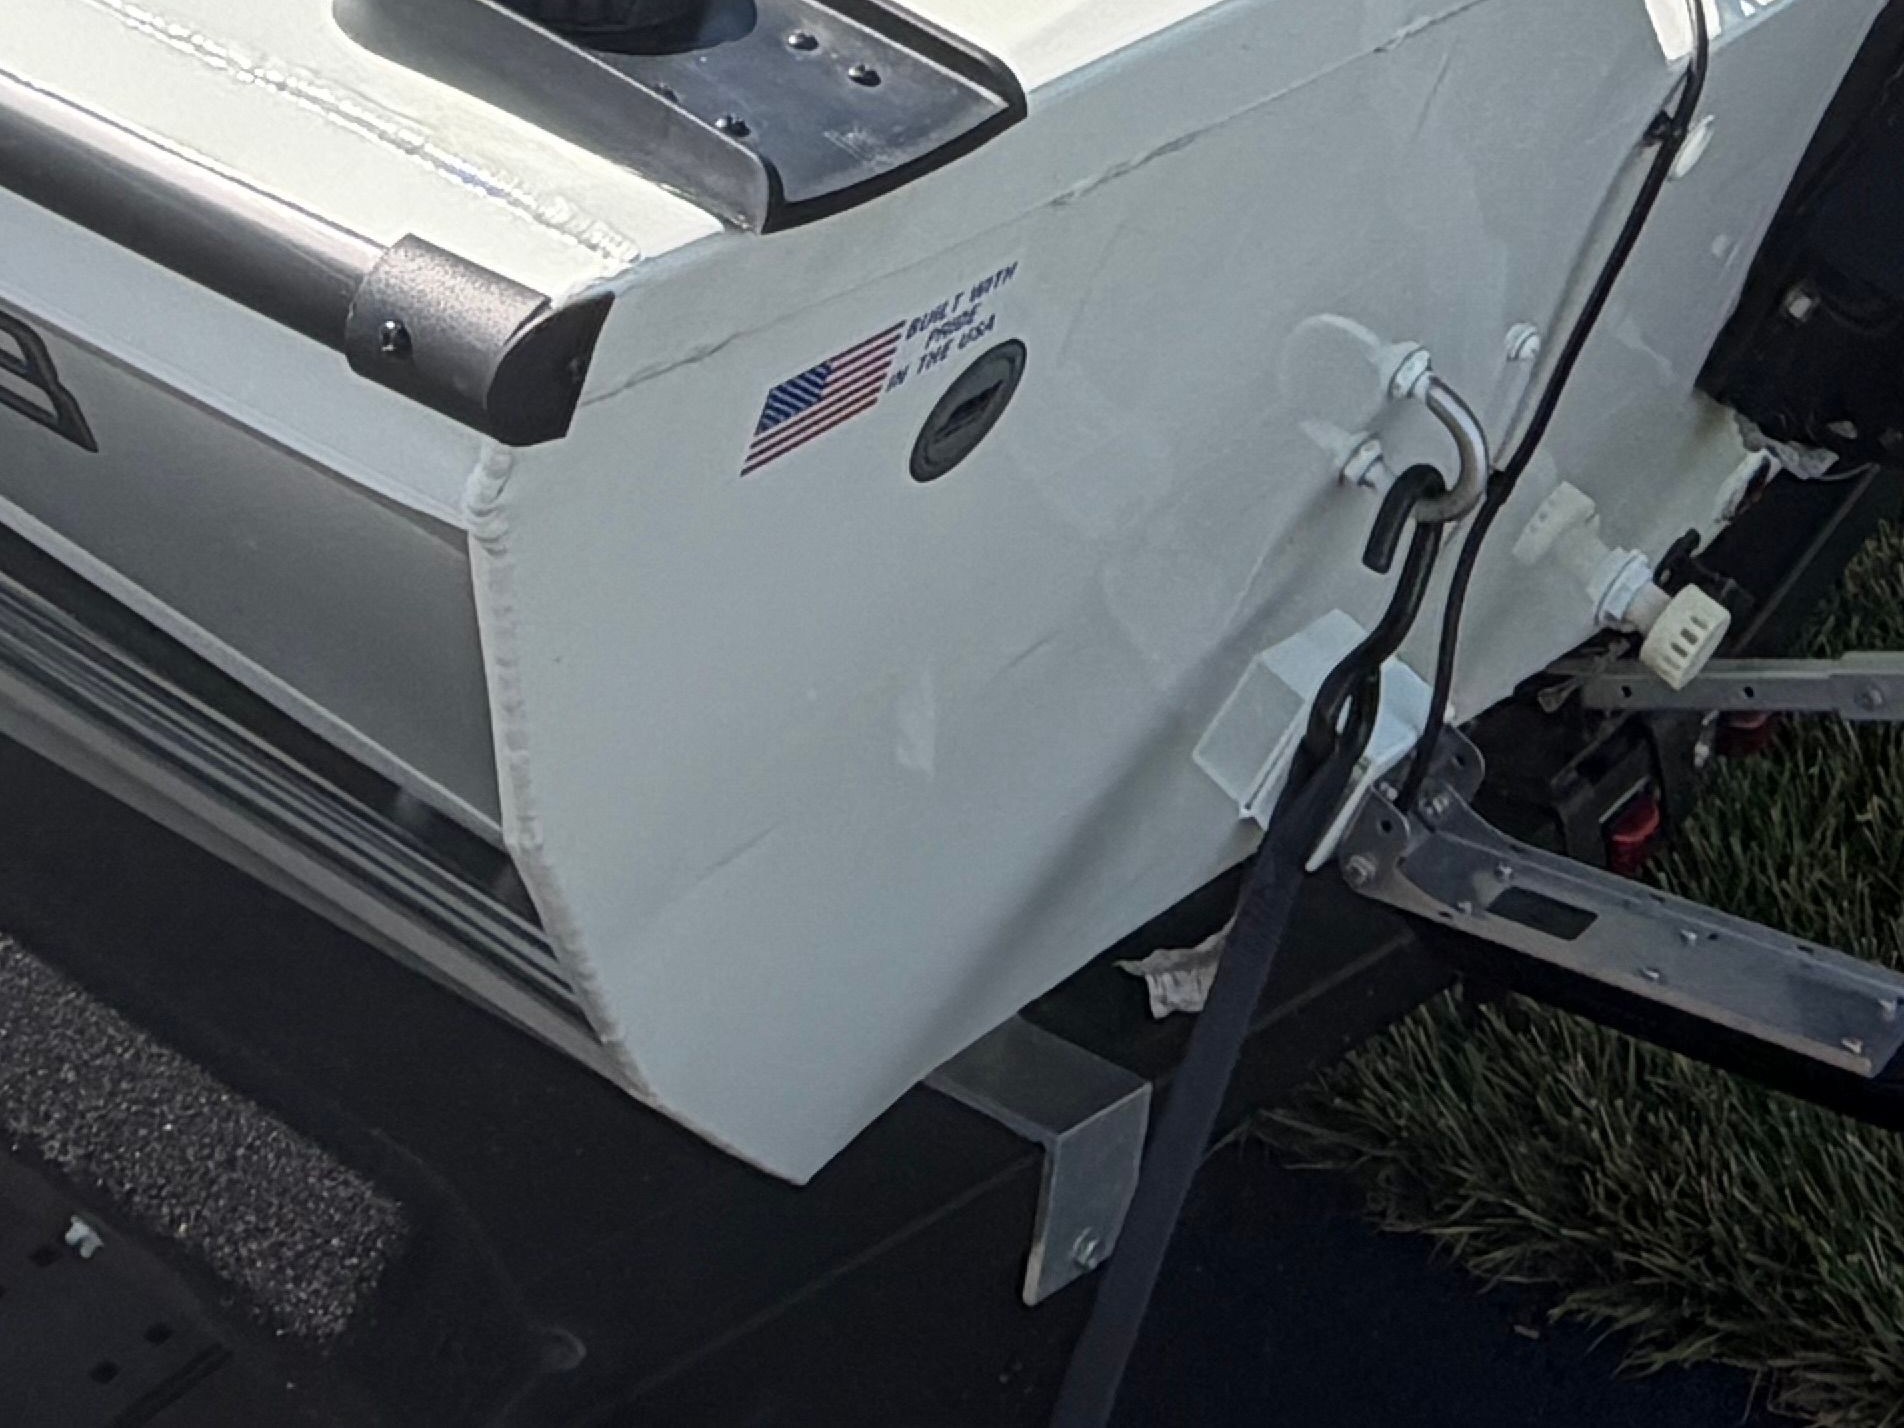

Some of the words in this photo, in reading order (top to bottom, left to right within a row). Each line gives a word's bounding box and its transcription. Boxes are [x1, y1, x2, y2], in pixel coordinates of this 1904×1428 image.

[906, 291, 965, 340] BUILT
[969, 260, 1018, 302] WITH
[925, 302, 982, 350] PRIDE
[917, 338, 954, 374] THE
[958, 313, 996, 349] USA
